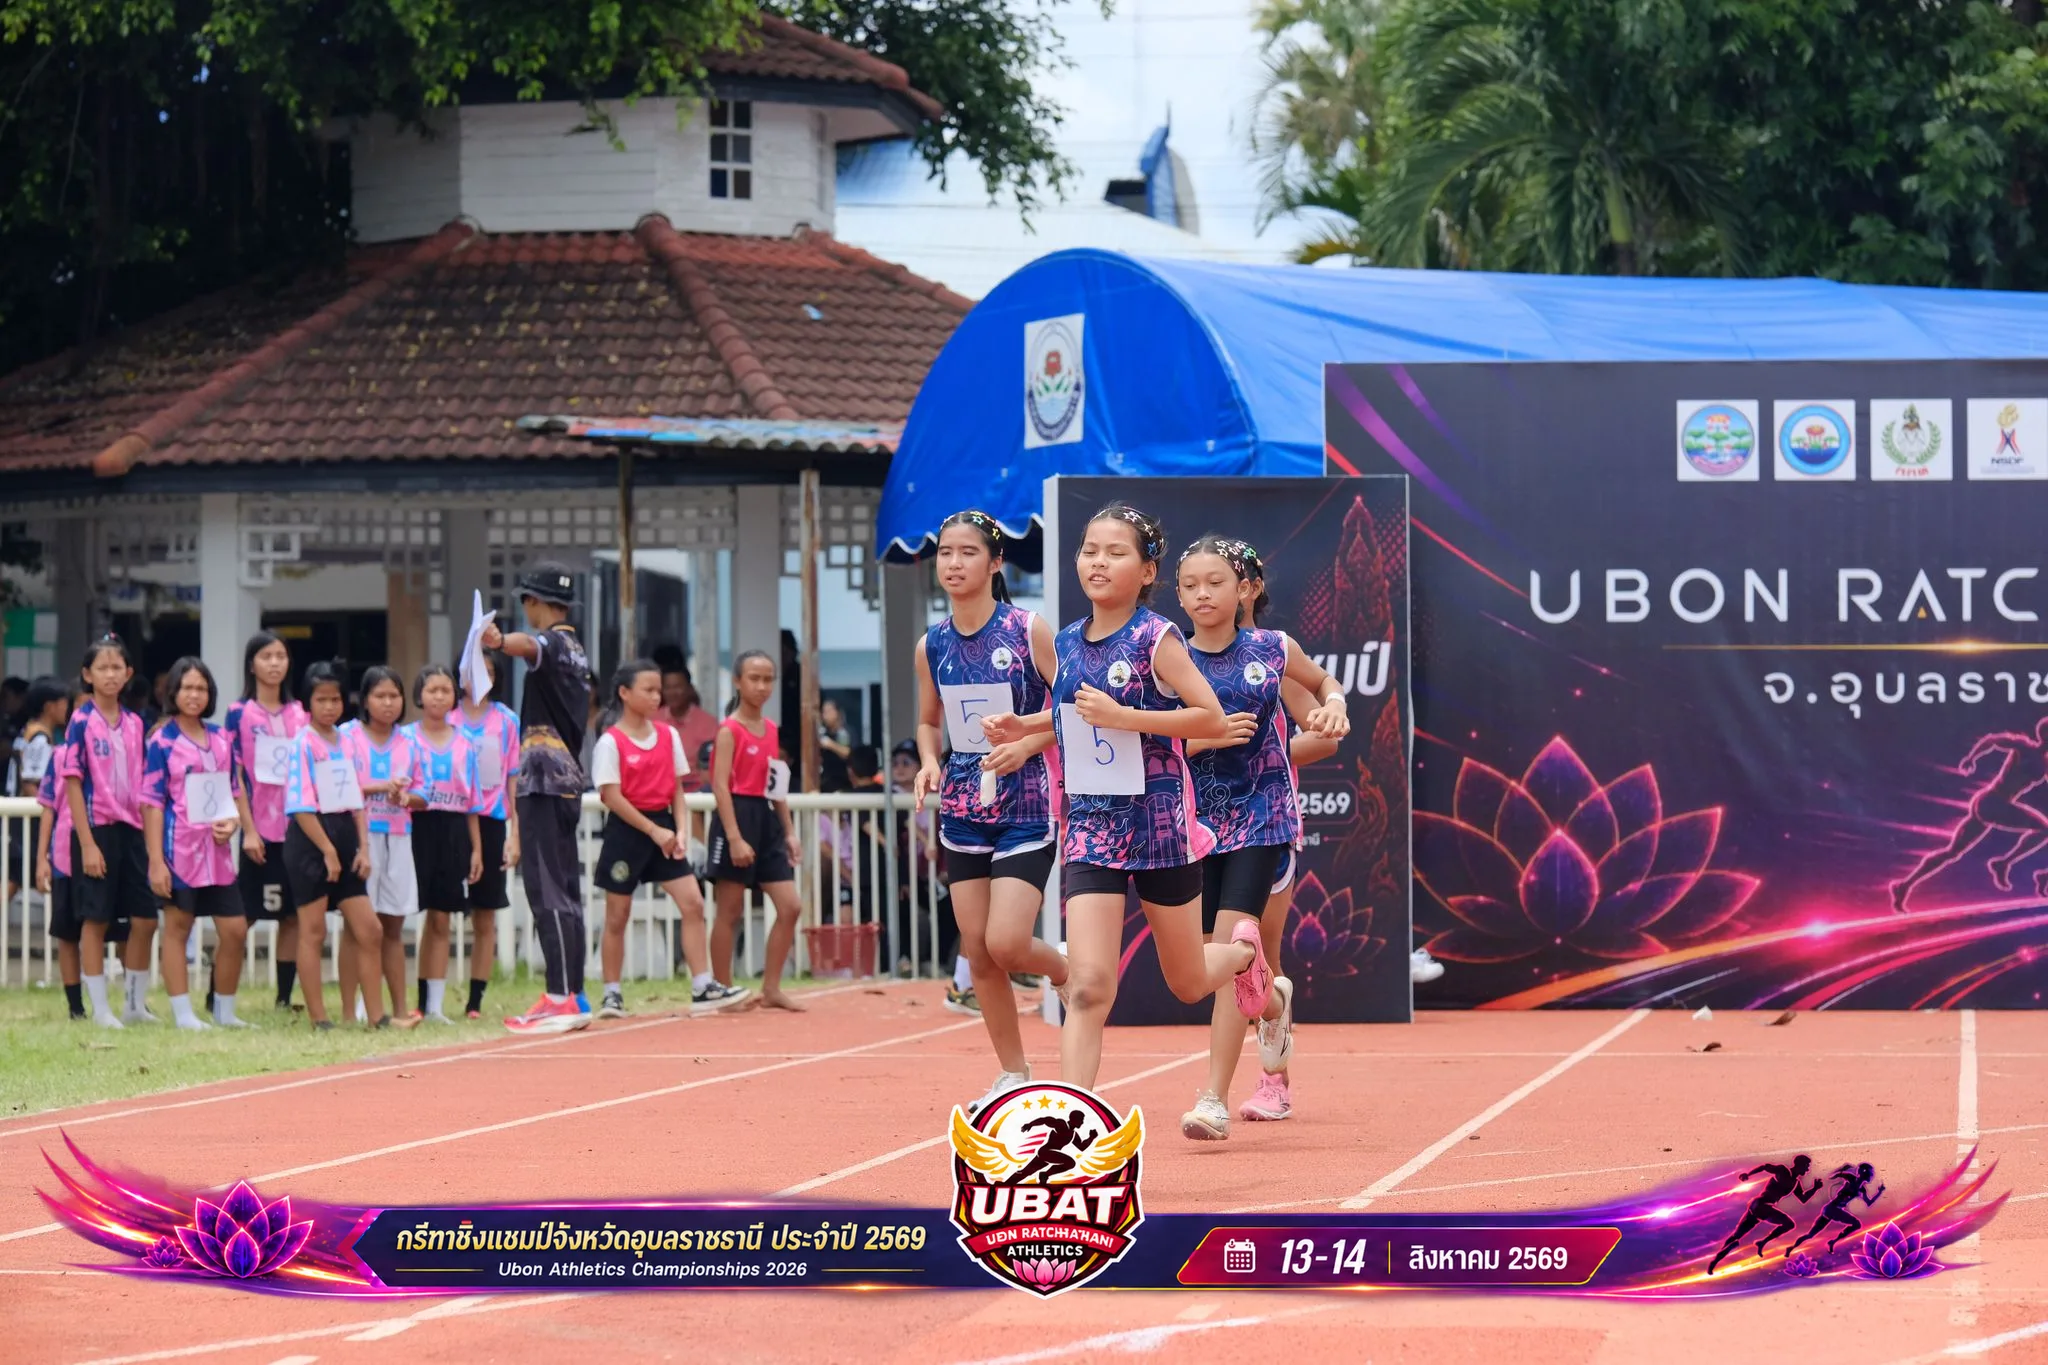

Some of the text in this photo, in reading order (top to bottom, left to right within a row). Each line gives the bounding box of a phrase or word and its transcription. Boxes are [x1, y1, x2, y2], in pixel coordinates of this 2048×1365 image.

[1529, 568, 2040, 624] UBON RATC
[960, 698, 989, 745] 5
[271, 745, 289, 778] 8
[1092, 724, 1115, 766] 5
[202, 779, 218, 818] 8
[331, 767, 351, 799] 7
[1298, 792, 1351, 815] 2569
[263, 883, 282, 912] 5
